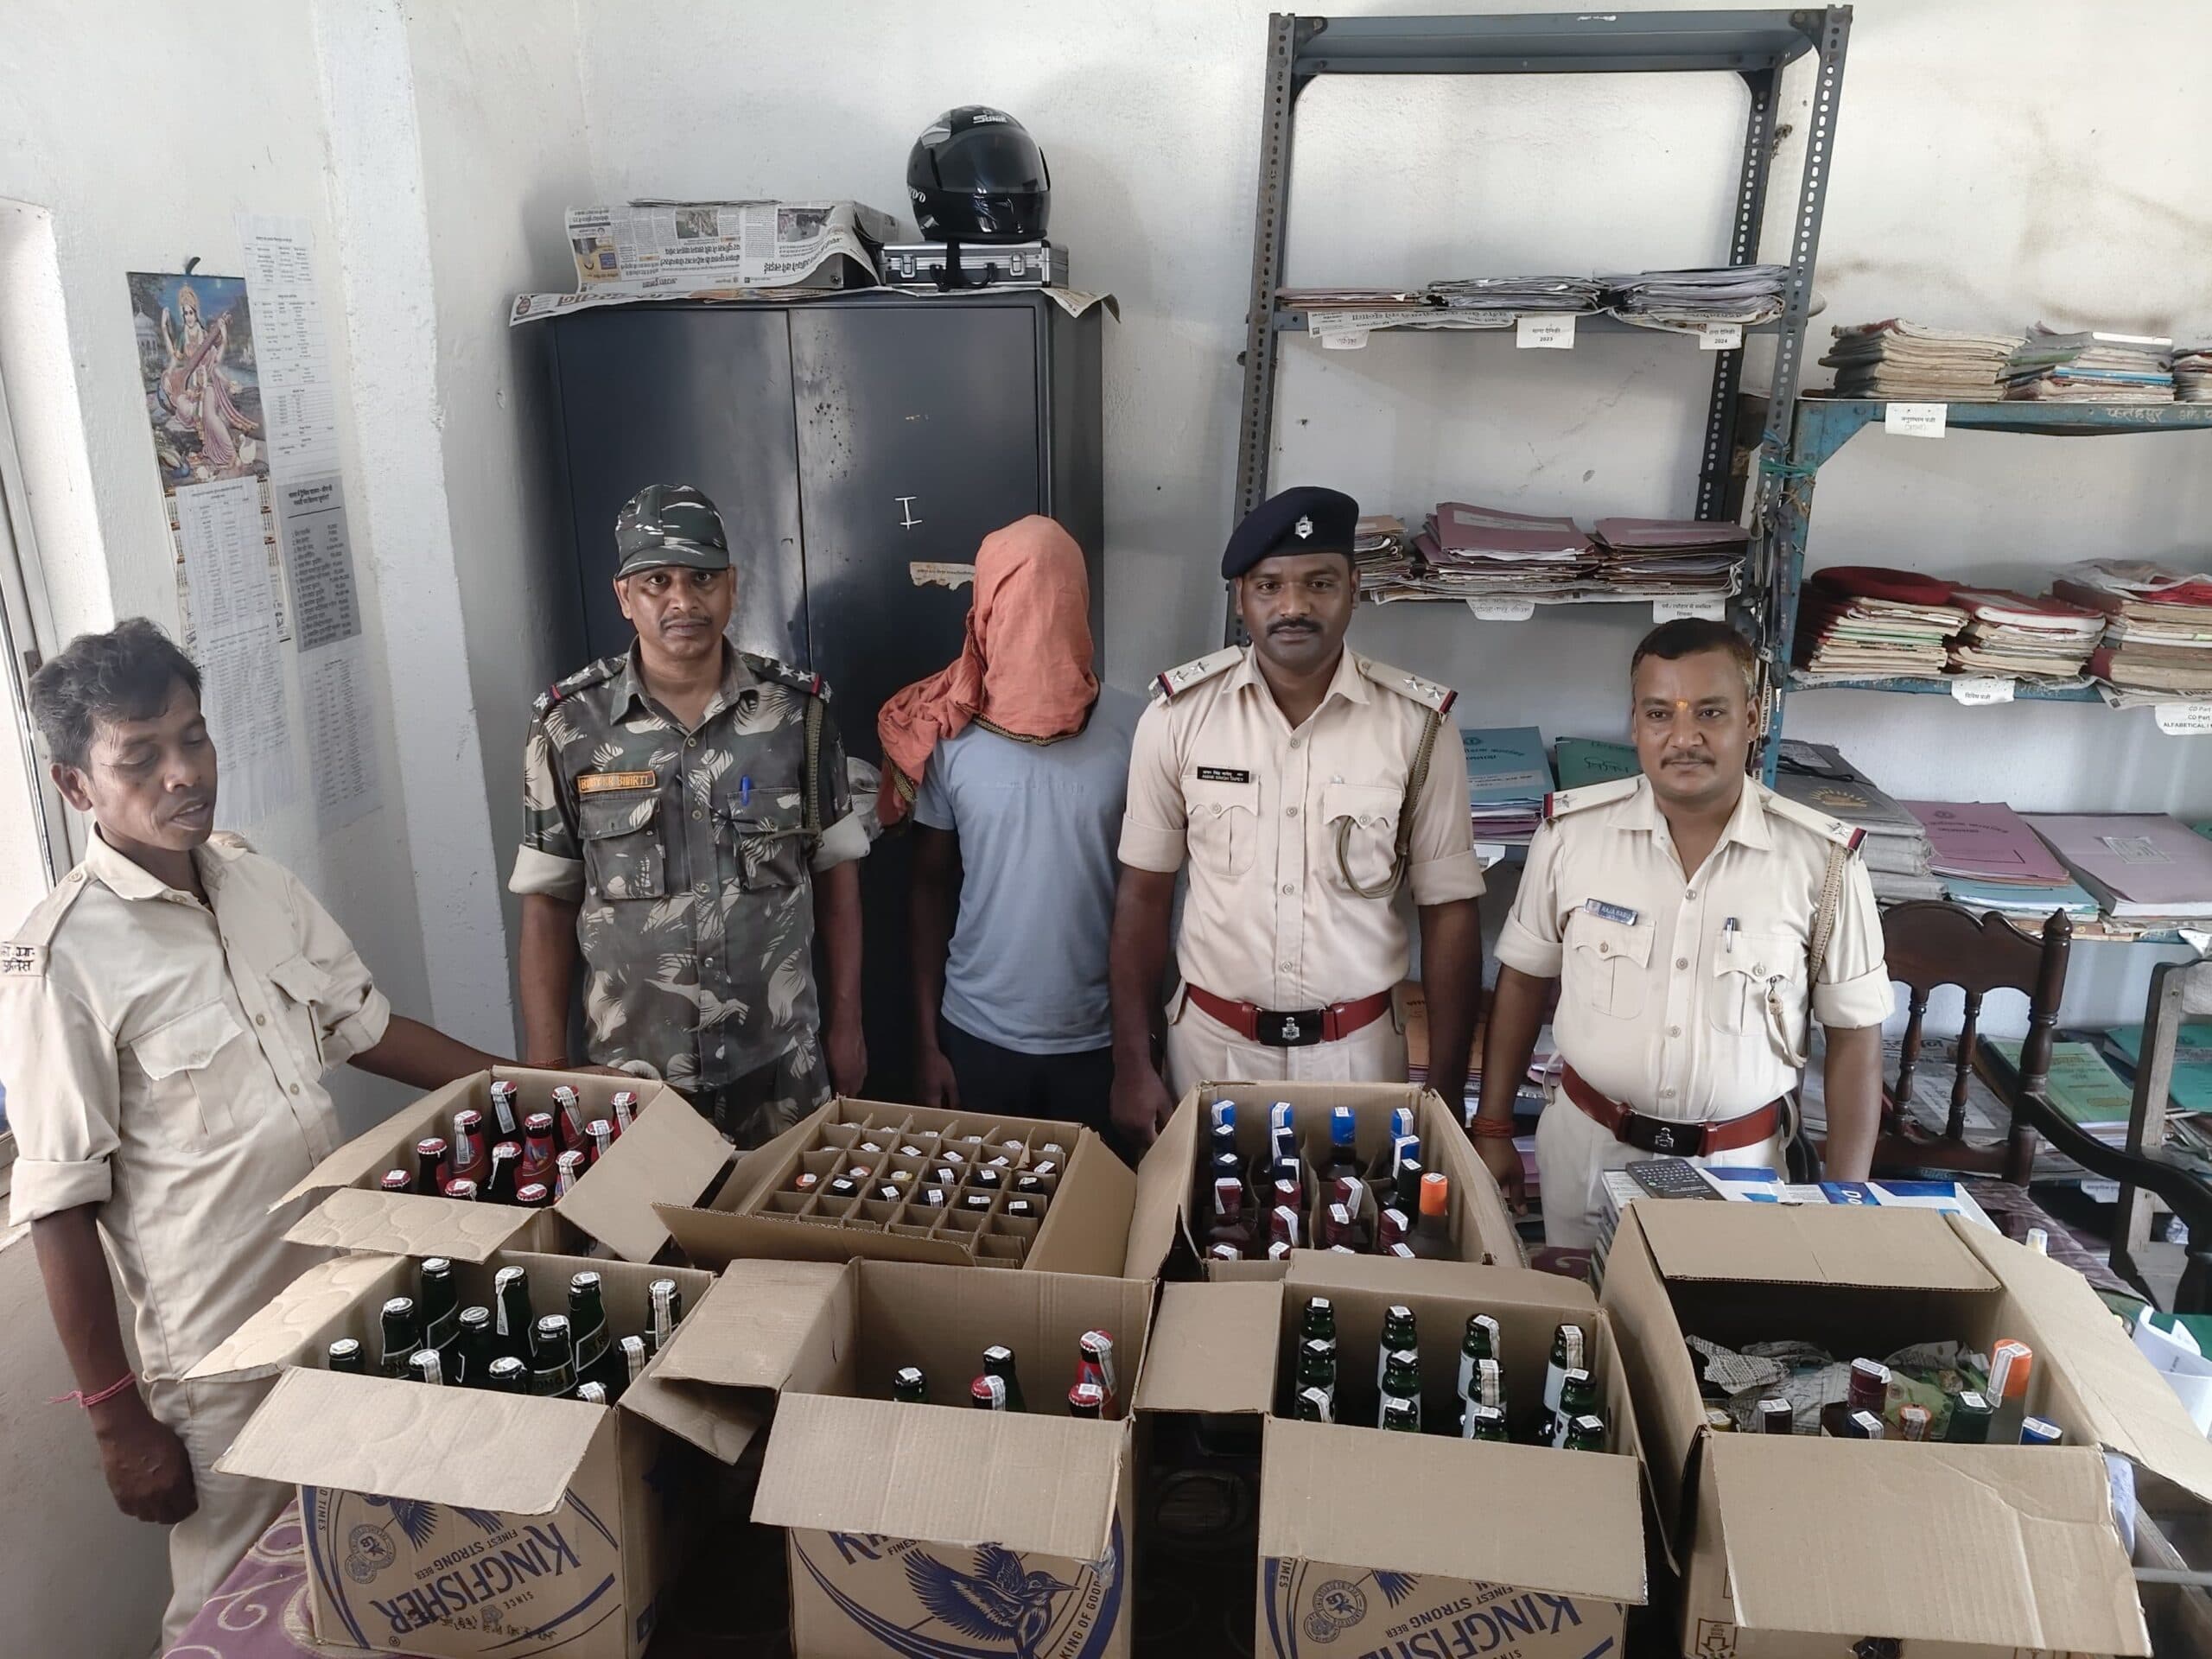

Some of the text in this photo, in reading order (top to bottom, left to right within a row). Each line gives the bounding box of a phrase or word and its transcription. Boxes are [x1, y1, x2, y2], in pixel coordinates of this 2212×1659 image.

[316, 1500, 327, 1532] TIMES
[415, 1529, 519, 1580] FINEST STRONG BEER
[887, 1539, 920, 1555] FINES
[369, 1522, 582, 1635] KINGFISHER
[504, 1592, 535, 1610] SINCE
[1409, 1598, 1471, 1629] STRONG
[1059, 1630, 1083, 1659] KING
[1078, 1612, 1091, 1628] OF
[1385, 1623, 1408, 1638] BEER
[1492, 1649, 1522, 1659] SIN
